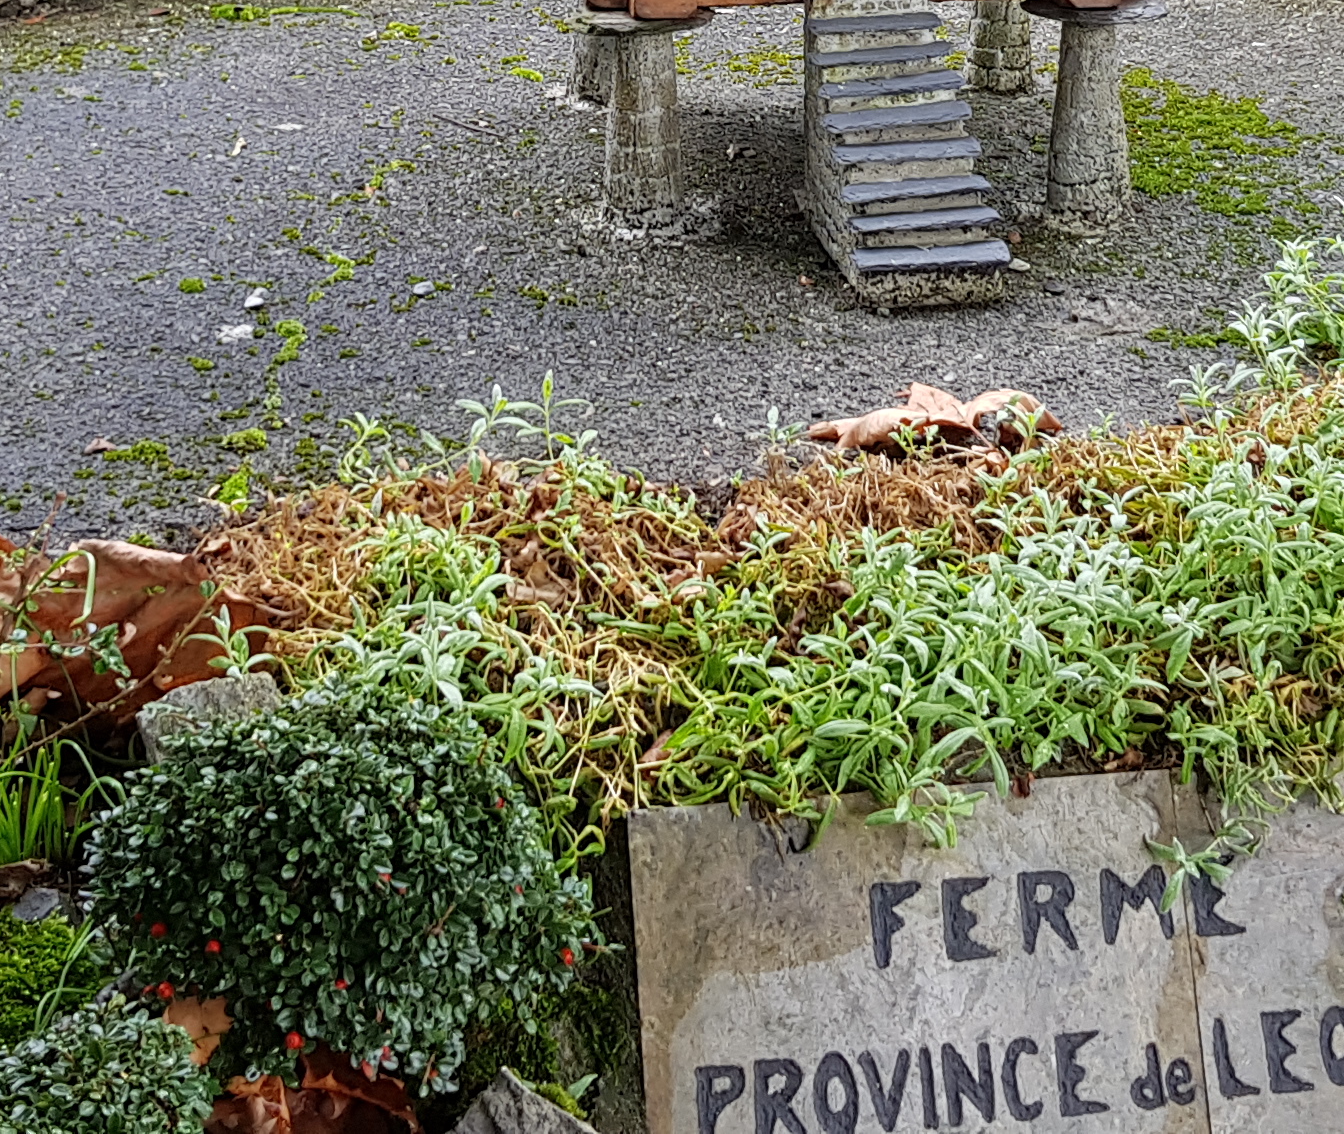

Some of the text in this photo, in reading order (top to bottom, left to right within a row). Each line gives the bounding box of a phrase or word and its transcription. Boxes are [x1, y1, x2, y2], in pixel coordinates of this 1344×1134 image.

[869, 855, 1247, 969] FERME
[695, 1030, 1110, 1134] PROVINCE
[1130, 1041, 1197, 1111] de
